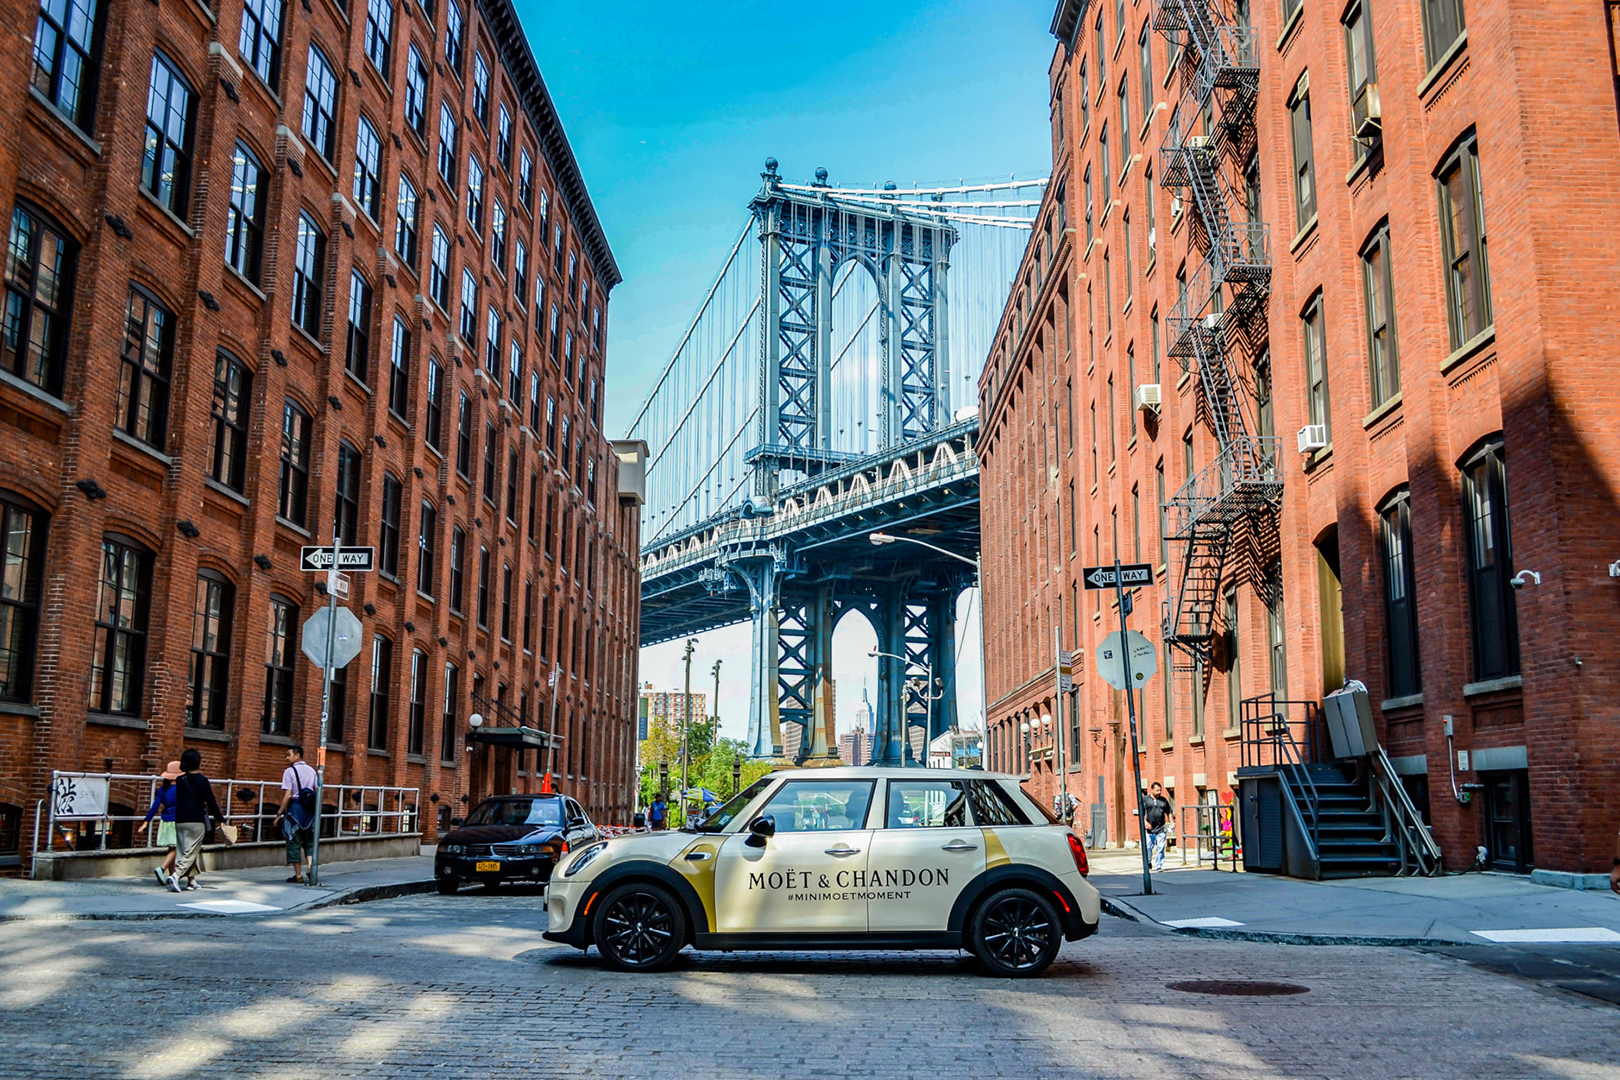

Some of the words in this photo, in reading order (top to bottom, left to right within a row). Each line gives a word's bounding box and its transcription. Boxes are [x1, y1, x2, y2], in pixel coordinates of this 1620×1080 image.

[312, 553, 333, 564] ONE
[342, 554, 364, 563] WAY
[1094, 572, 1114, 583] ONE
[1122, 570, 1144, 581] WAY
[748, 868, 812, 890] MOËT
[818, 873, 831, 889] &
[836, 868, 950, 889] CHANDON
[787, 891, 912, 902] #MINIMOETMOMENT
